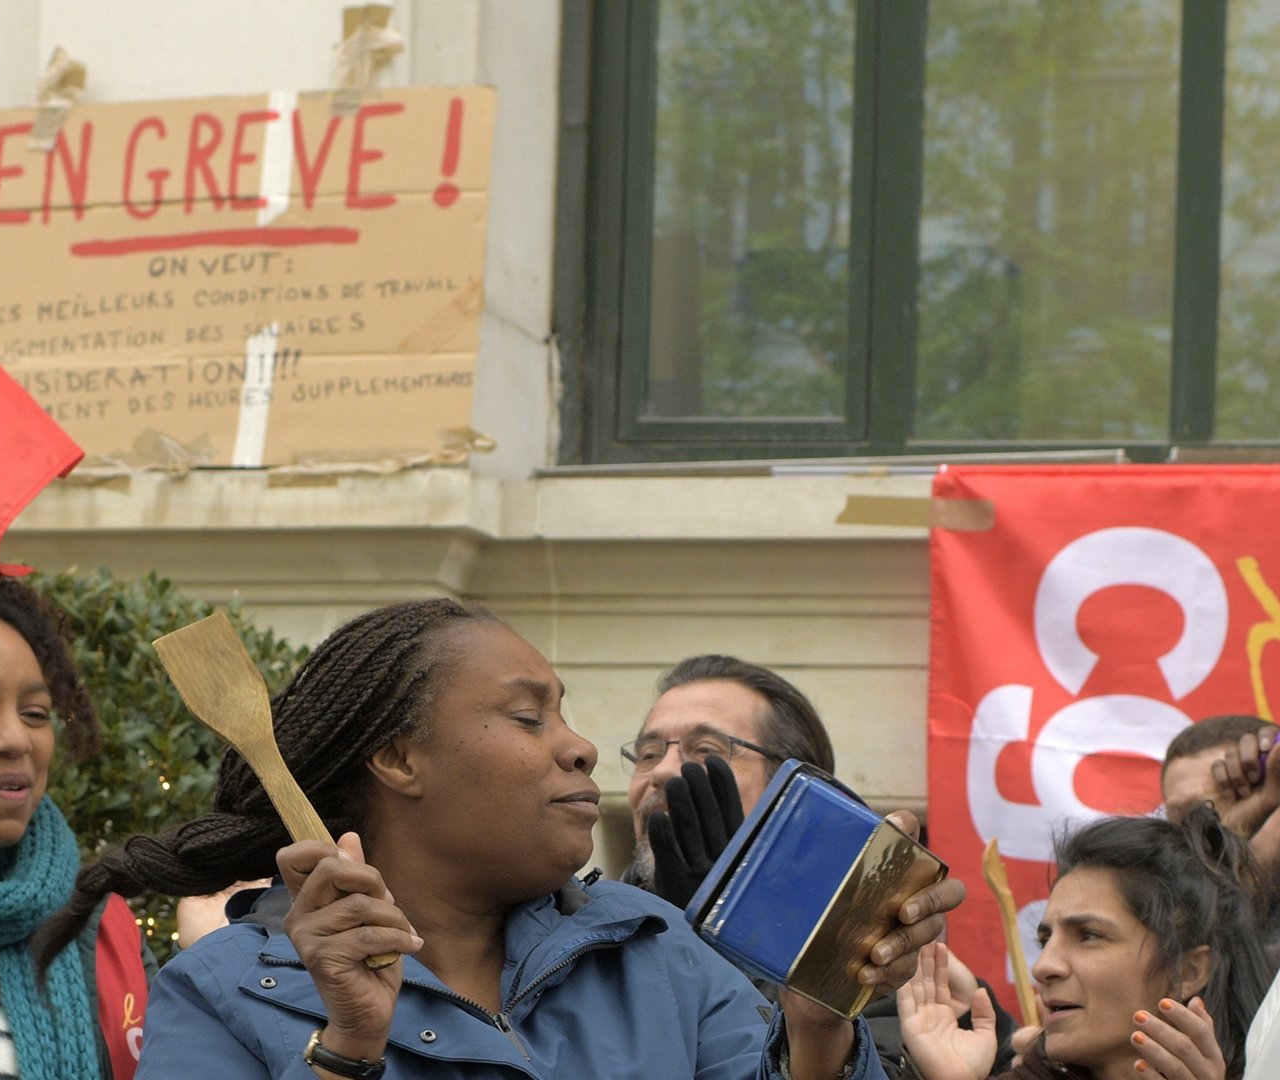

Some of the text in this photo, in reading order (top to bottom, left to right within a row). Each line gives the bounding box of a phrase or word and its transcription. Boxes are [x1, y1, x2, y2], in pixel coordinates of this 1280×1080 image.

[147, 256, 188, 277] ON
[185, 324, 225, 343] DES
[126, 392, 176, 415] DES
